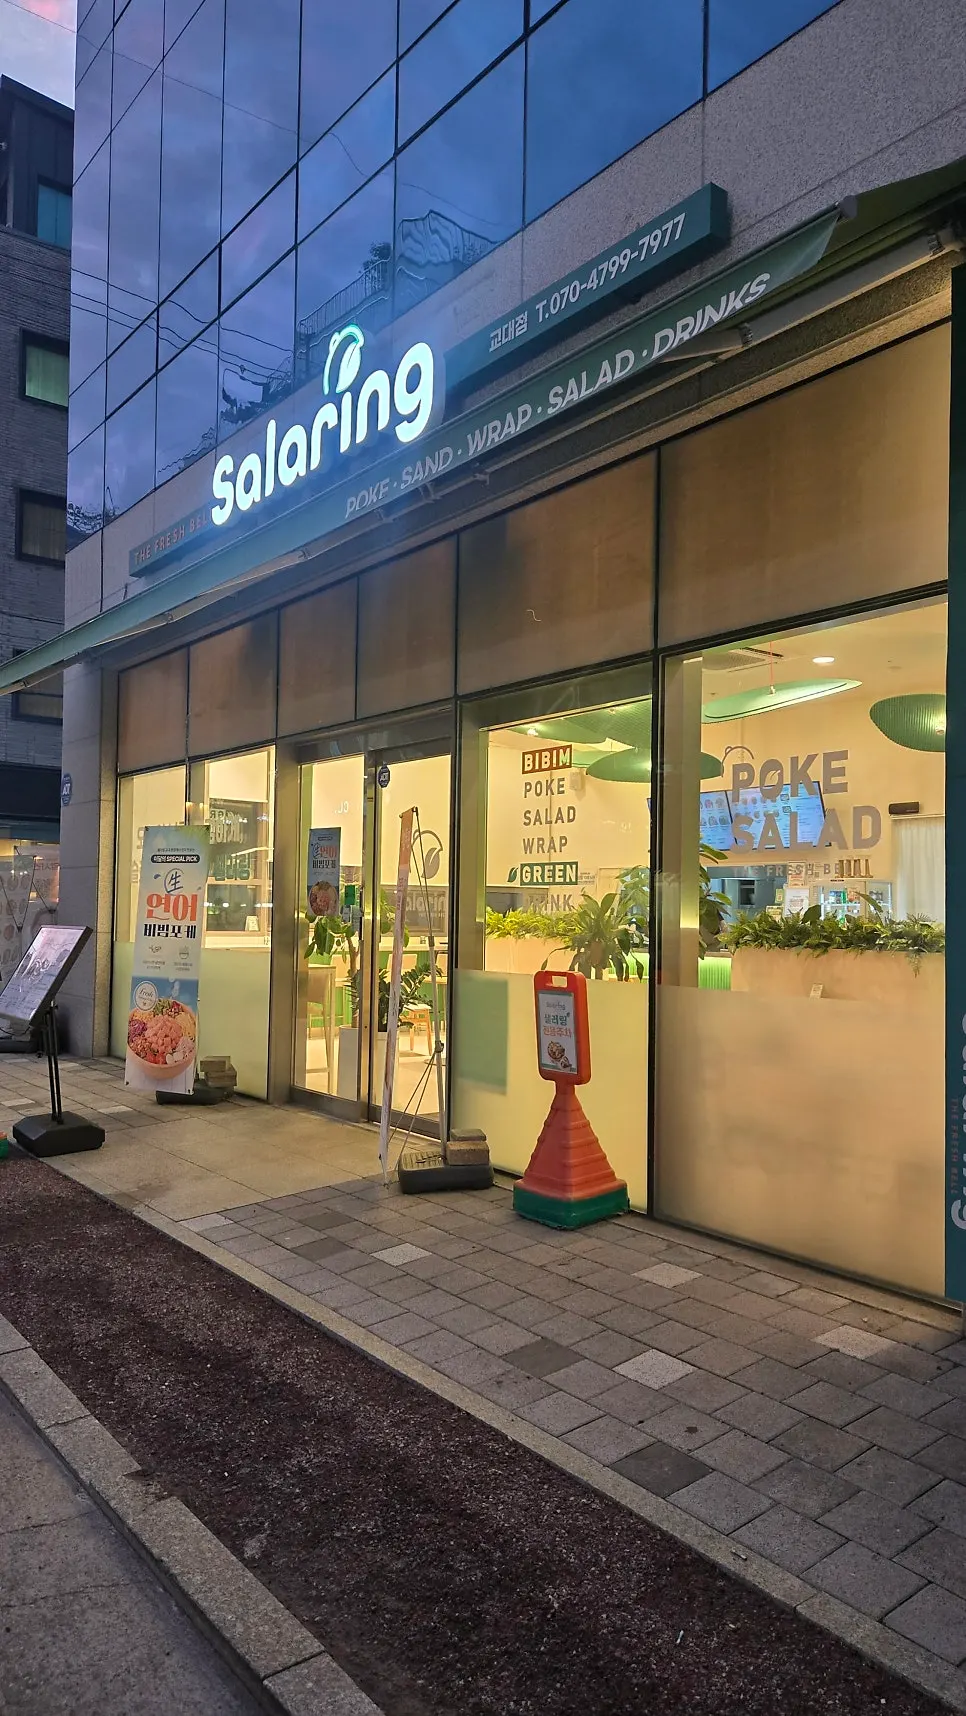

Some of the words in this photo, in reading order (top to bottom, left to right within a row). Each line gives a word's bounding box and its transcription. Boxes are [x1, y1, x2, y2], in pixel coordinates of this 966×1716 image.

[488, 311, 528, 352] 교대점
[535, 212, 686, 322] T.070-4799-7977
[400, 446, 453, 490] SAND
[466, 403, 532, 457] WRAP
[547, 349, 635, 415] SALAD
[651, 272, 771, 360] DRINKS
[134, 545, 151, 565] THE
[154, 525, 185, 552] FRESH
[523, 747, 570, 772] BIBIM
[523, 777, 566, 799] POKE
[732, 749, 849, 803] POKE
[523, 805, 577, 827] SALAD
[729, 805, 882, 855] SALAD
[522, 835, 568, 855] WRAP
[521, 864, 577, 883] GREEN
[766, 863, 814, 878] FRESH
[146, 893, 198, 921] 연어
[143, 923, 197, 938] 비빔포케
